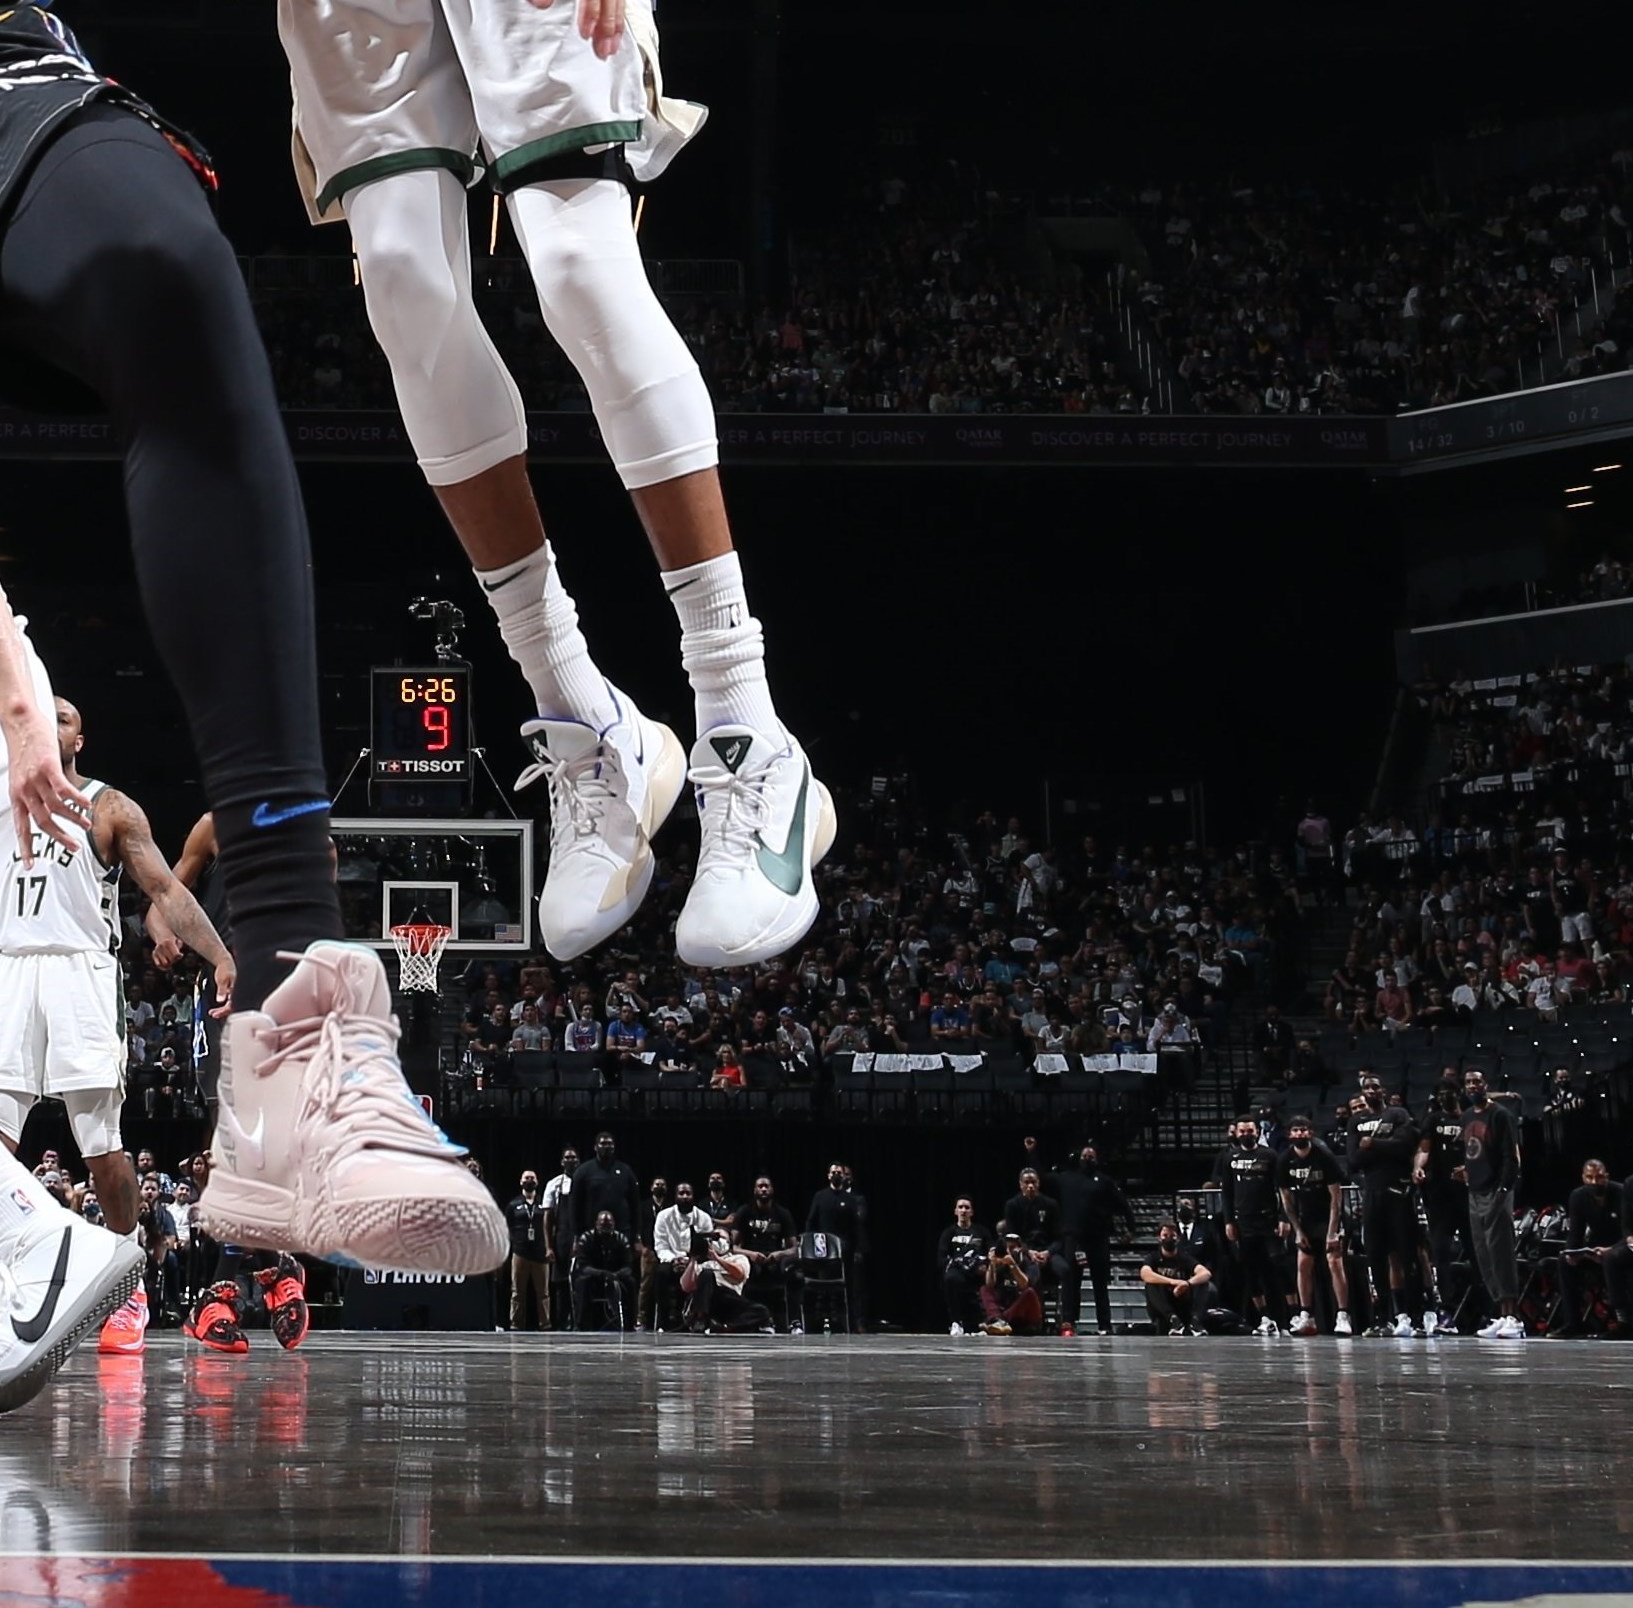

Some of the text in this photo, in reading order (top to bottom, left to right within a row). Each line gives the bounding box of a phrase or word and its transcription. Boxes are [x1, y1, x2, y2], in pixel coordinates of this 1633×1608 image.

[20, 424, 33, 438] A
[38, 424, 111, 439] PERFECT
[297, 426, 382, 442] DISCOVER
[771, 429, 844, 445] PERFECT
[850, 429, 928, 447] JOURNEY
[955, 428, 1003, 444] QATAR
[1031, 431, 1116, 447] DISCOVER
[1139, 431, 1211, 447] PERFECT
[1216, 432, 1293, 449] JOURNEY
[1320, 430, 1367, 444] QATAR
[401, 678, 456, 703] 6:26
[423, 706, 448, 750] 9
[401, 760, 465, 772] TISSOT
[16, 875, 48, 917] 17
